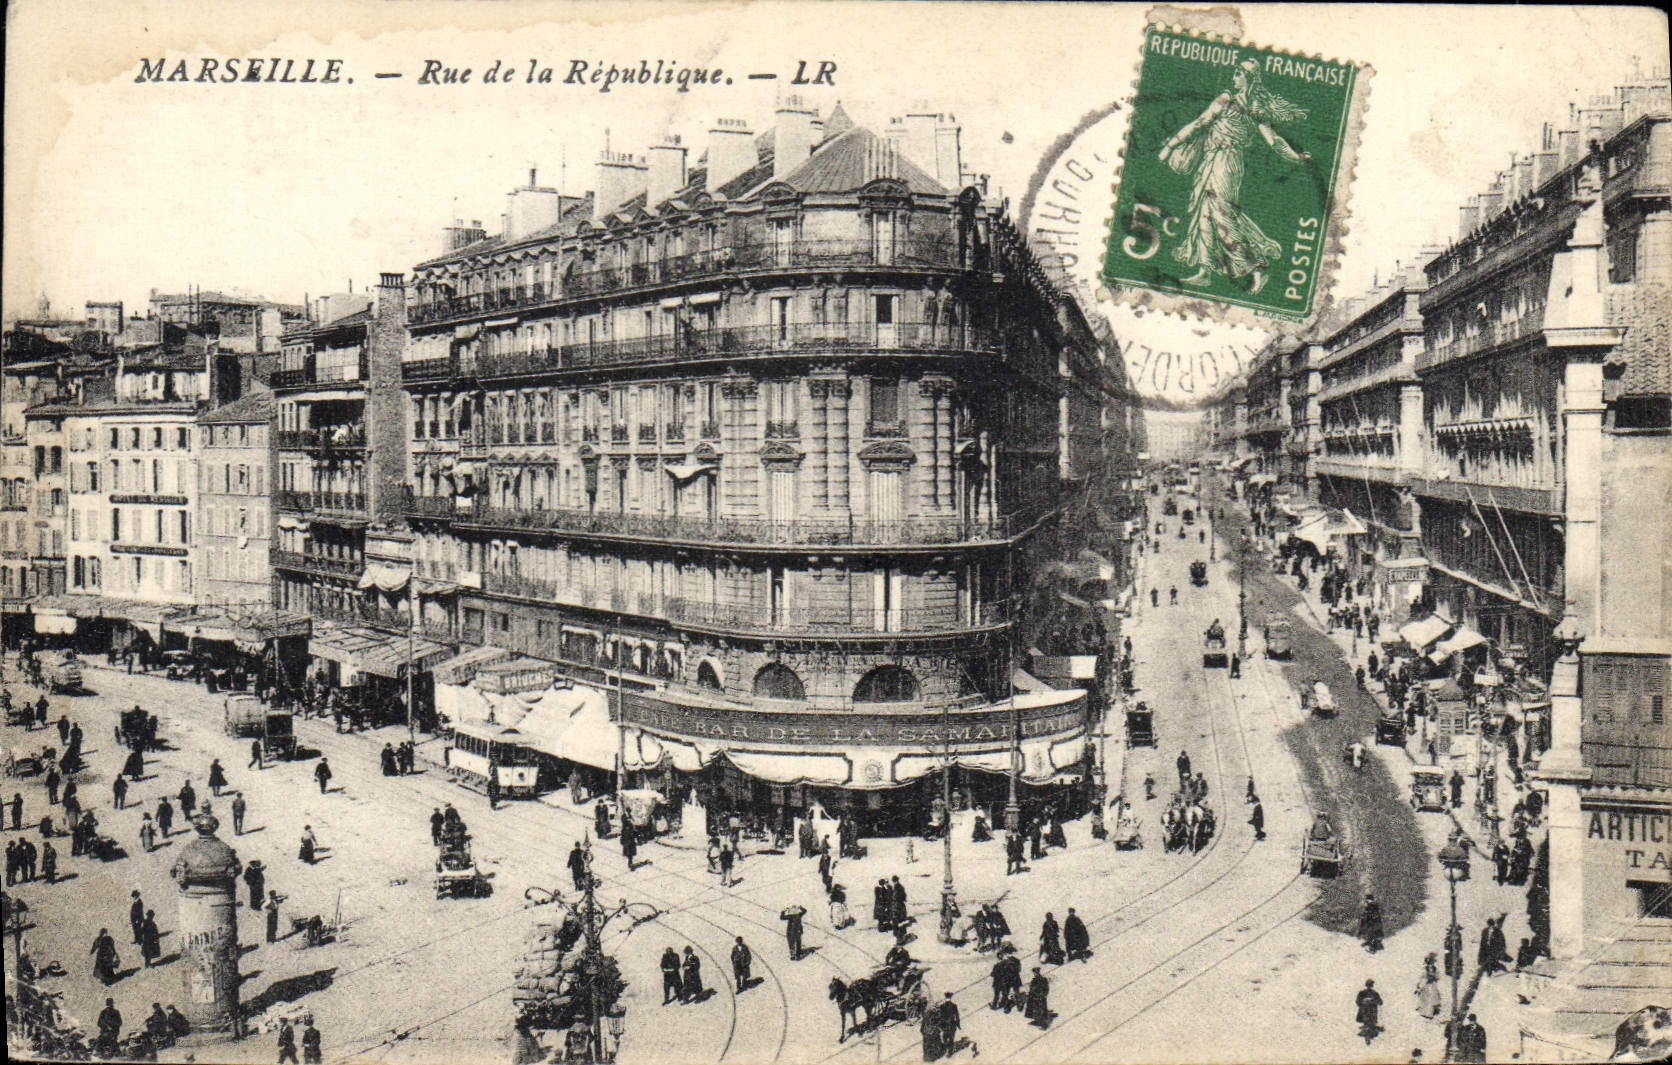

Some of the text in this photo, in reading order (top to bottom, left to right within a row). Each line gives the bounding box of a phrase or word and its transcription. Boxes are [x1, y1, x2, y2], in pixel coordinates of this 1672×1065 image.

[1265, 55, 1346, 87] FRANÇAISE
[1284, 216, 1319, 301] POSTES
[694, 721, 751, 739] BAR
[768, 727, 811, 741] DE
[831, 728, 881, 742] LA
[897, 713, 1084, 743] SAMARITAI
